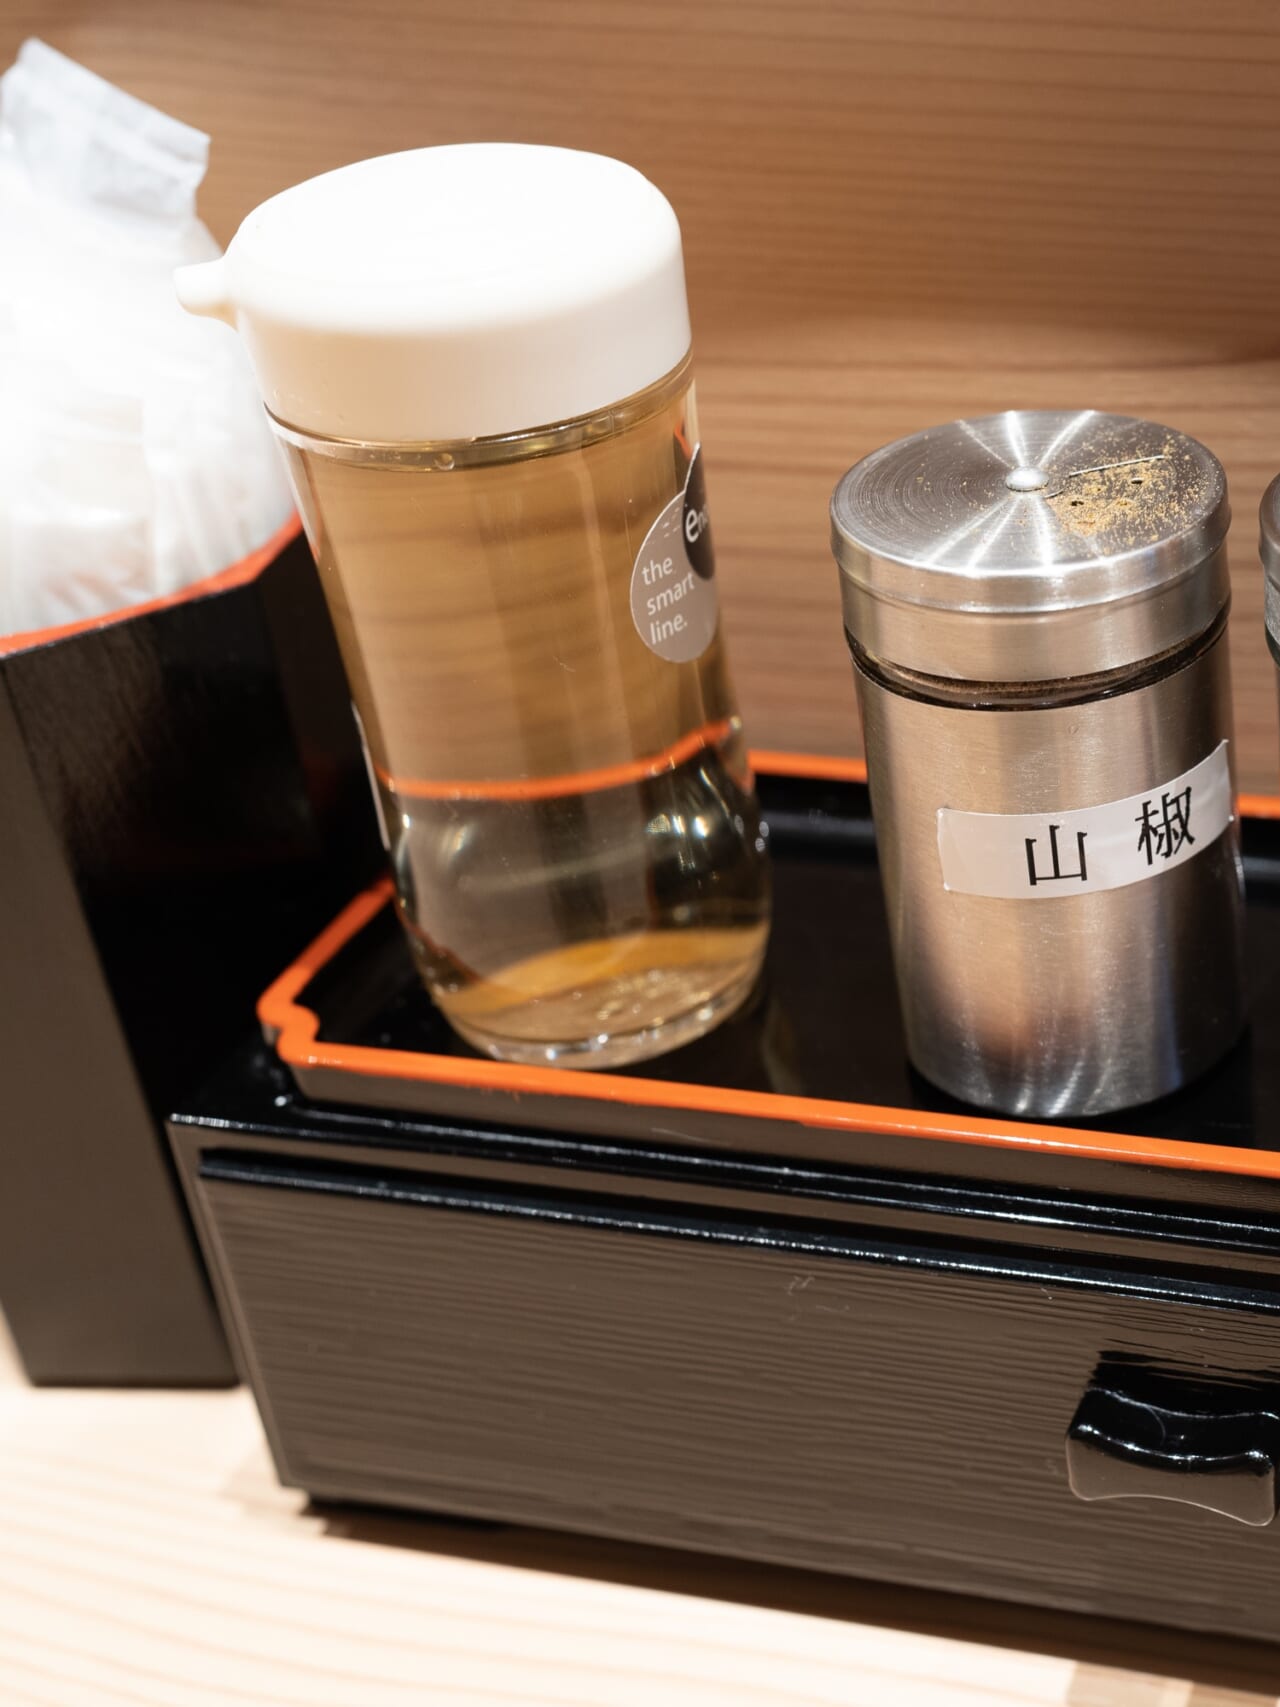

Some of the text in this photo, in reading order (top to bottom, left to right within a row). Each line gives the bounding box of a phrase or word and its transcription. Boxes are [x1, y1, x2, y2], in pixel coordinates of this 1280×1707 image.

[641, 557, 673, 585] the
[646, 573, 695, 615] smart
[650, 614, 688, 645] line.
[1024, 786, 1196, 886] 山椒
